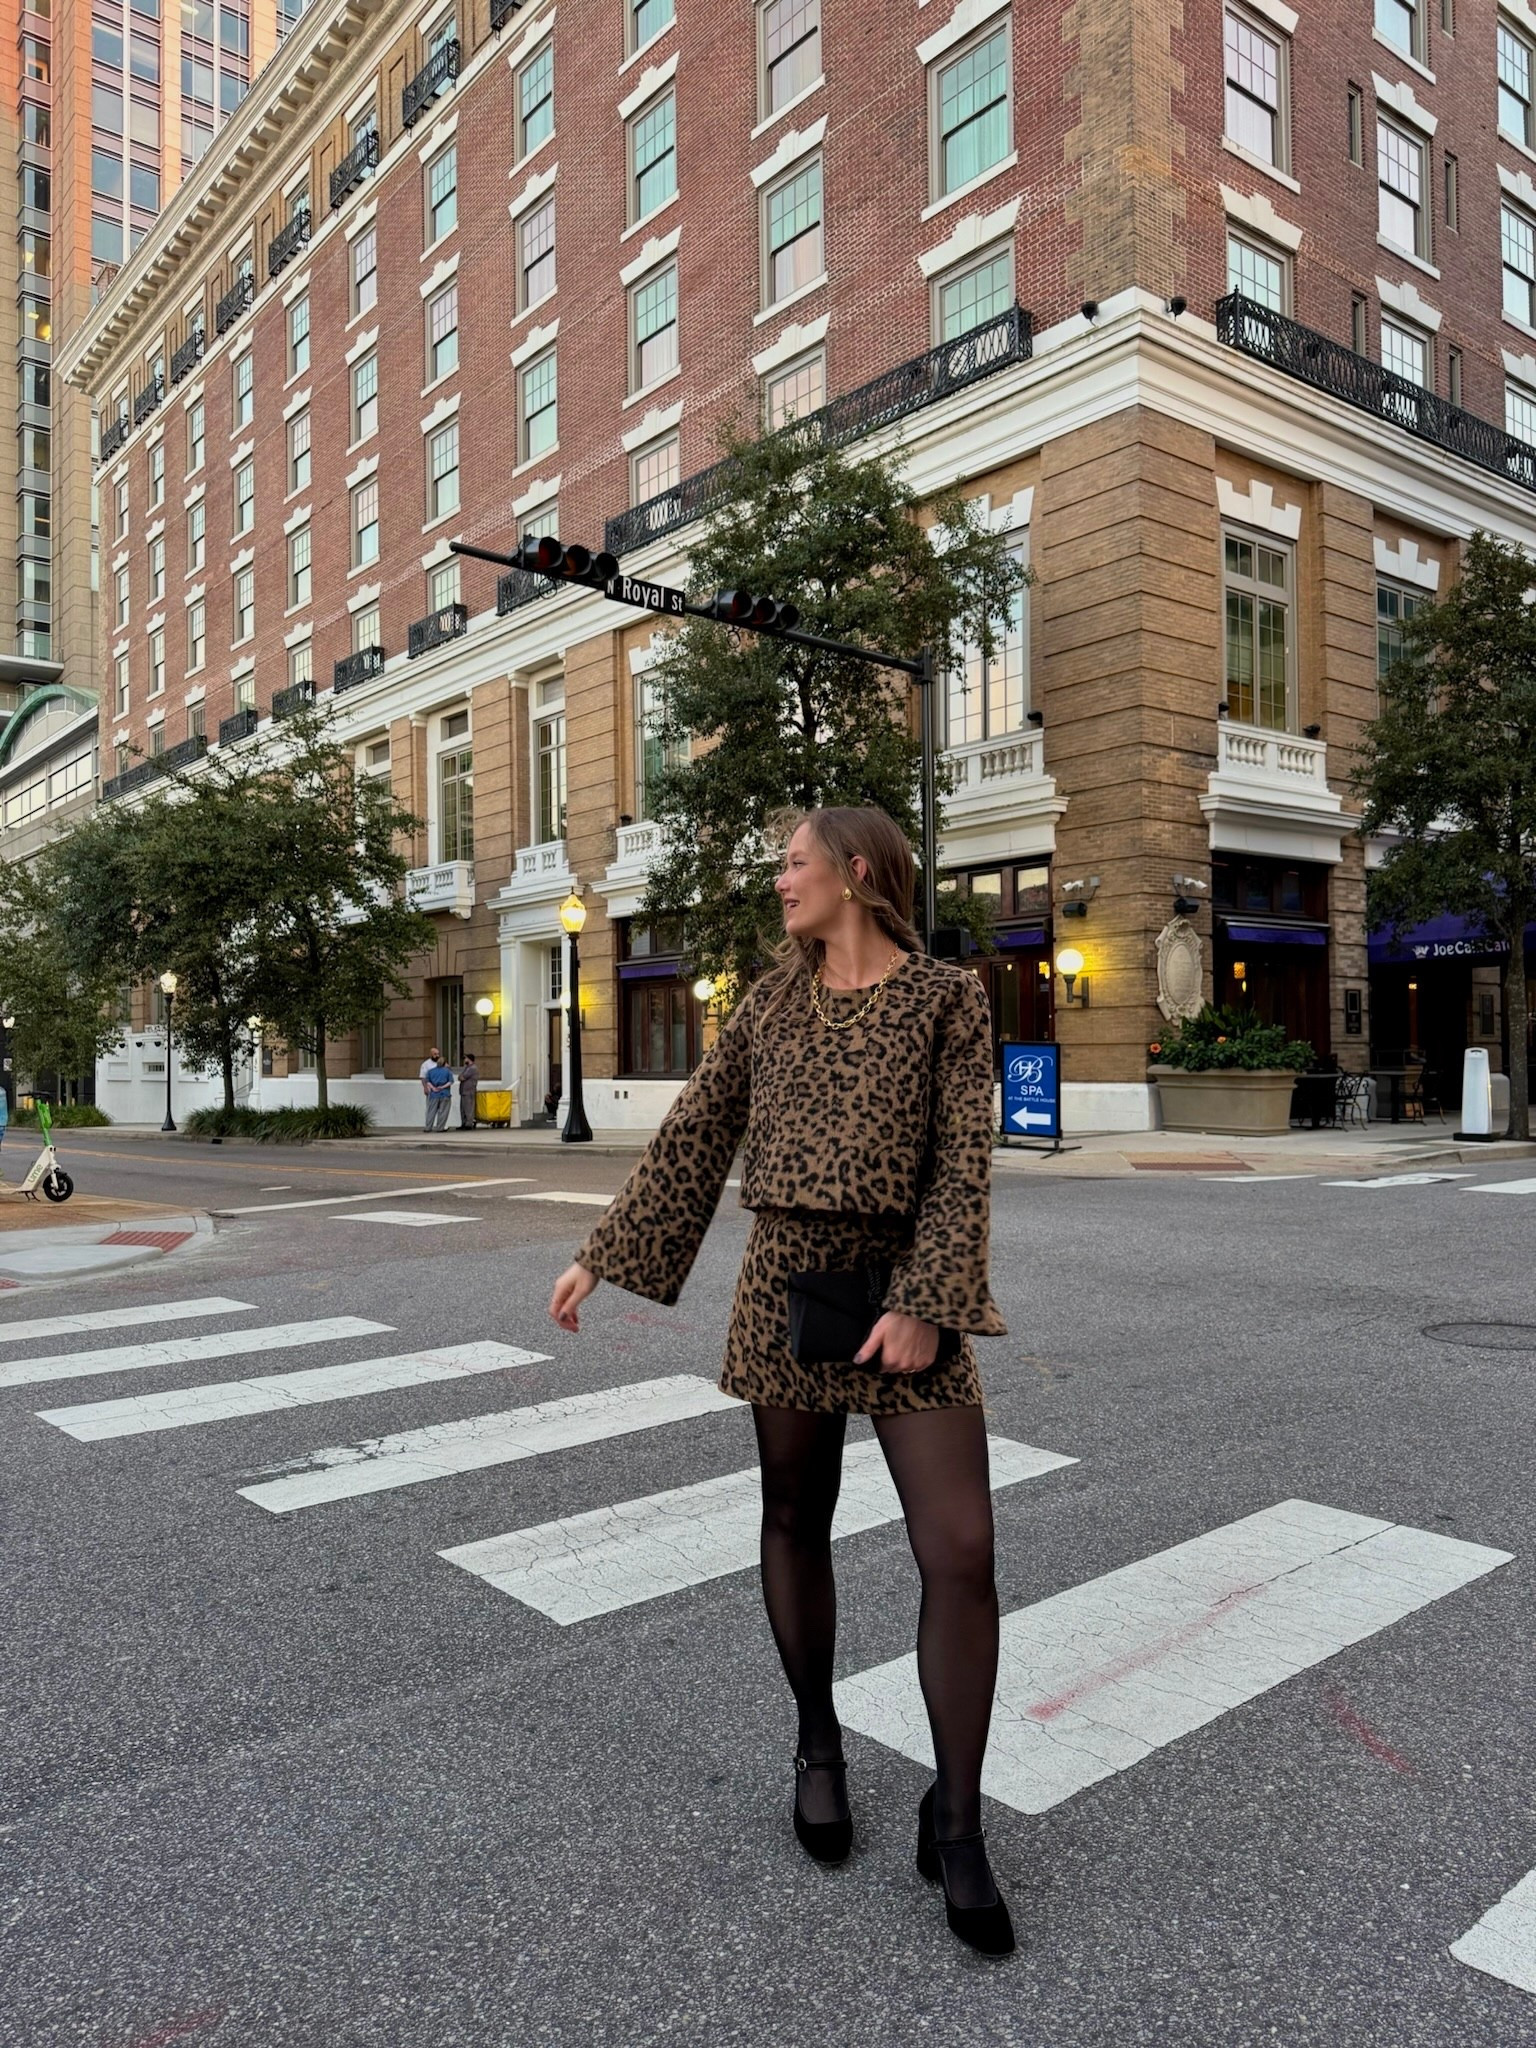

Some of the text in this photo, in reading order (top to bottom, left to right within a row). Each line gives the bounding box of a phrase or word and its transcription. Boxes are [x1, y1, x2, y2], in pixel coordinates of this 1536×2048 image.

[607, 576, 683, 612] N Royal St
[1020, 1085, 1044, 1096] SPA
